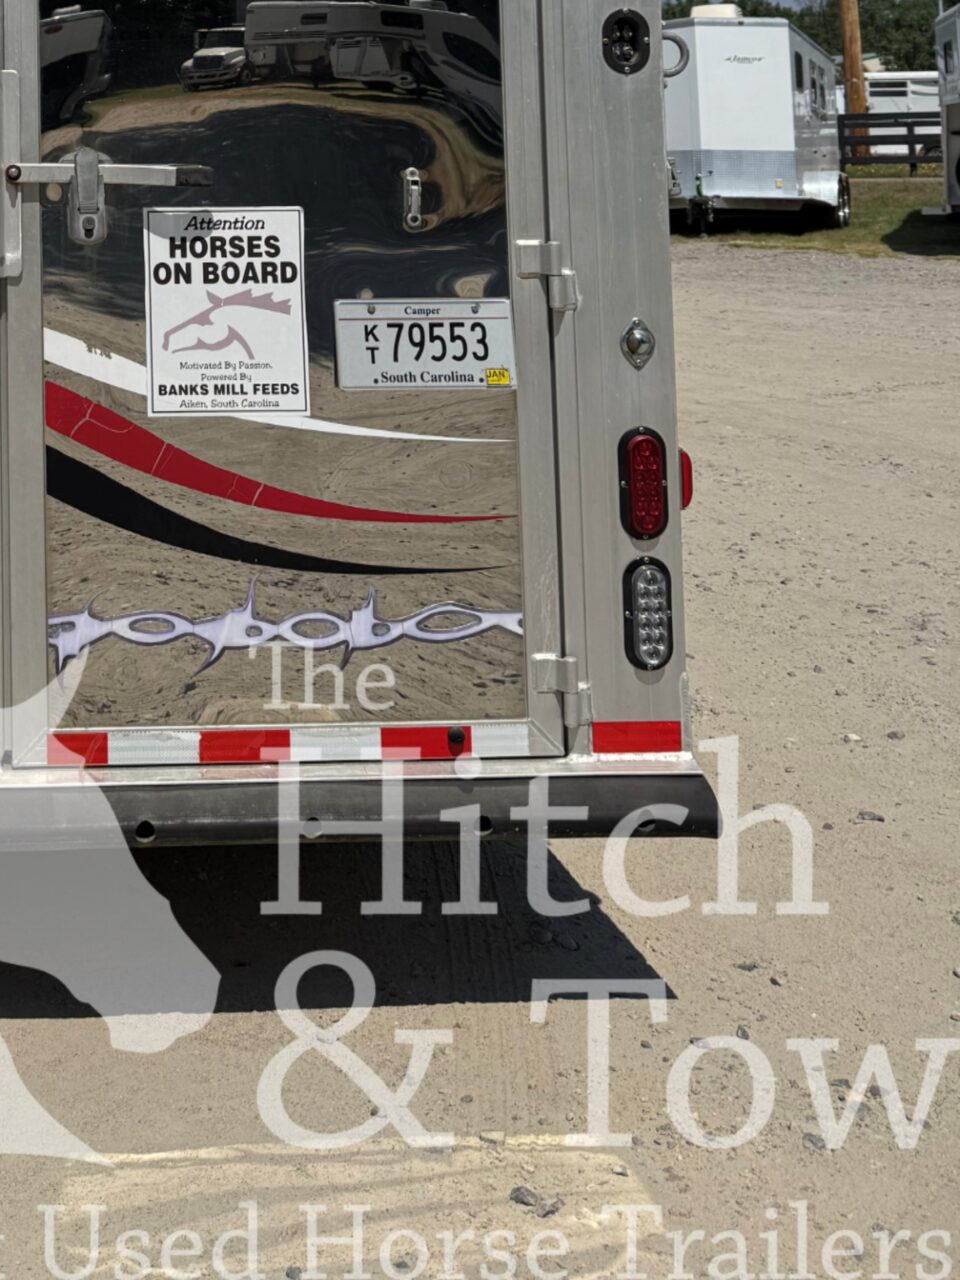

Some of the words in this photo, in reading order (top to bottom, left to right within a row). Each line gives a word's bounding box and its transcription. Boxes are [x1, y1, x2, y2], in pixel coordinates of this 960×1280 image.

[184, 216, 265, 231] Attention
[169, 235, 281, 259] HORSES
[153, 262, 192, 285] ON
[202, 261, 298, 285] BOARD
[404, 306, 441, 316] Camper
[387, 322, 489, 363] 79553
[179, 361, 222, 370] Motivated
[224, 361, 237, 371] By
[201, 373, 238, 382] Powered
[239, 373, 252, 383] By
[381, 371, 416, 383] South
[420, 371, 475, 383] Carolina
[487, 369, 505, 378] JAN
[158, 384, 209, 396] BANKS
[214, 384, 248, 395] MILL
[253, 383, 300, 395] FEEDS
[210, 399, 239, 409] South
[240, 399, 280, 408] Carolina
